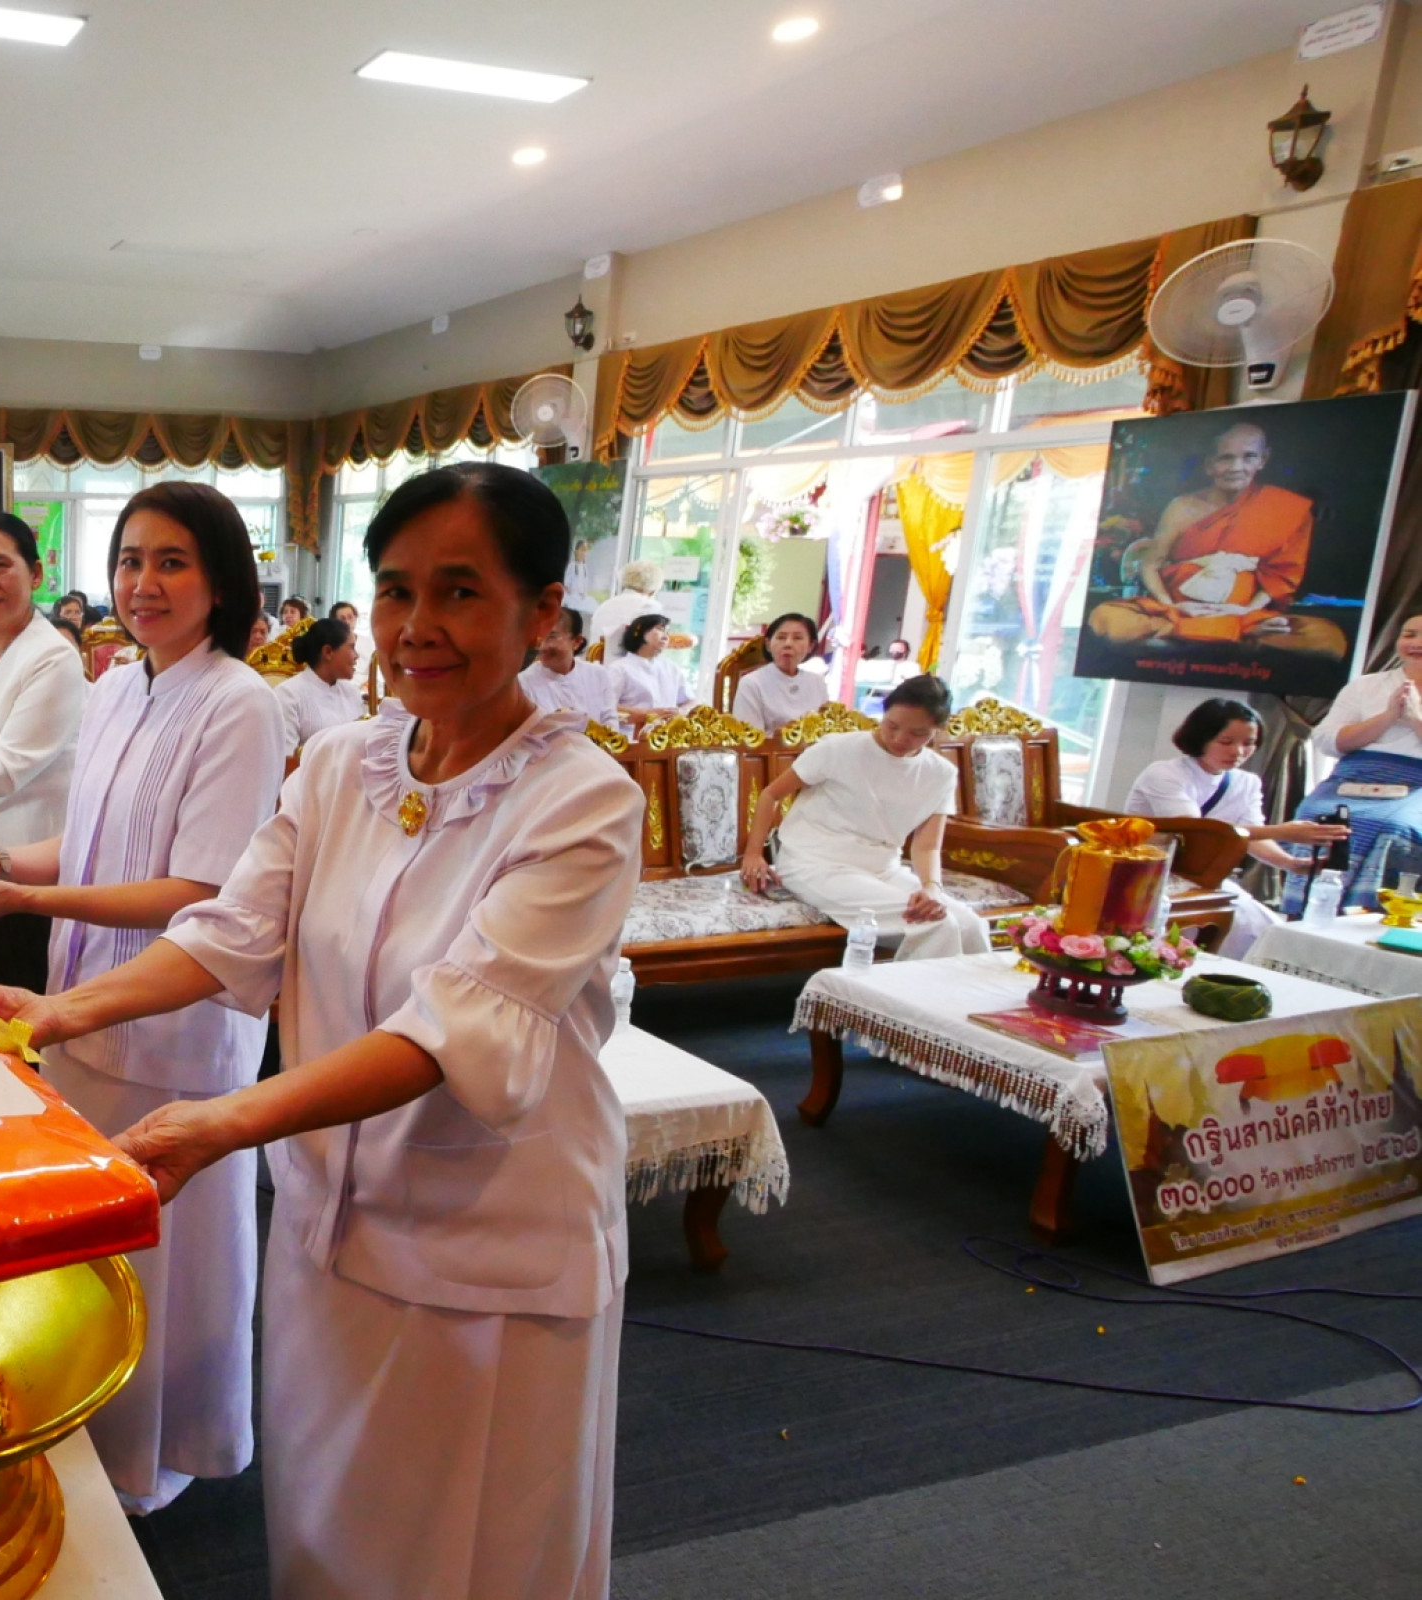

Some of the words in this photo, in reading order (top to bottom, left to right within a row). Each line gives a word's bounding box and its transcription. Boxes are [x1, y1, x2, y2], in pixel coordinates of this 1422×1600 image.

[1184, 1085, 1392, 1166] กฐินสามัคคีทั่วไทย
[1260, 1165, 1279, 1190] วัด
[1282, 1152, 1355, 1191] พุทธศักราช
